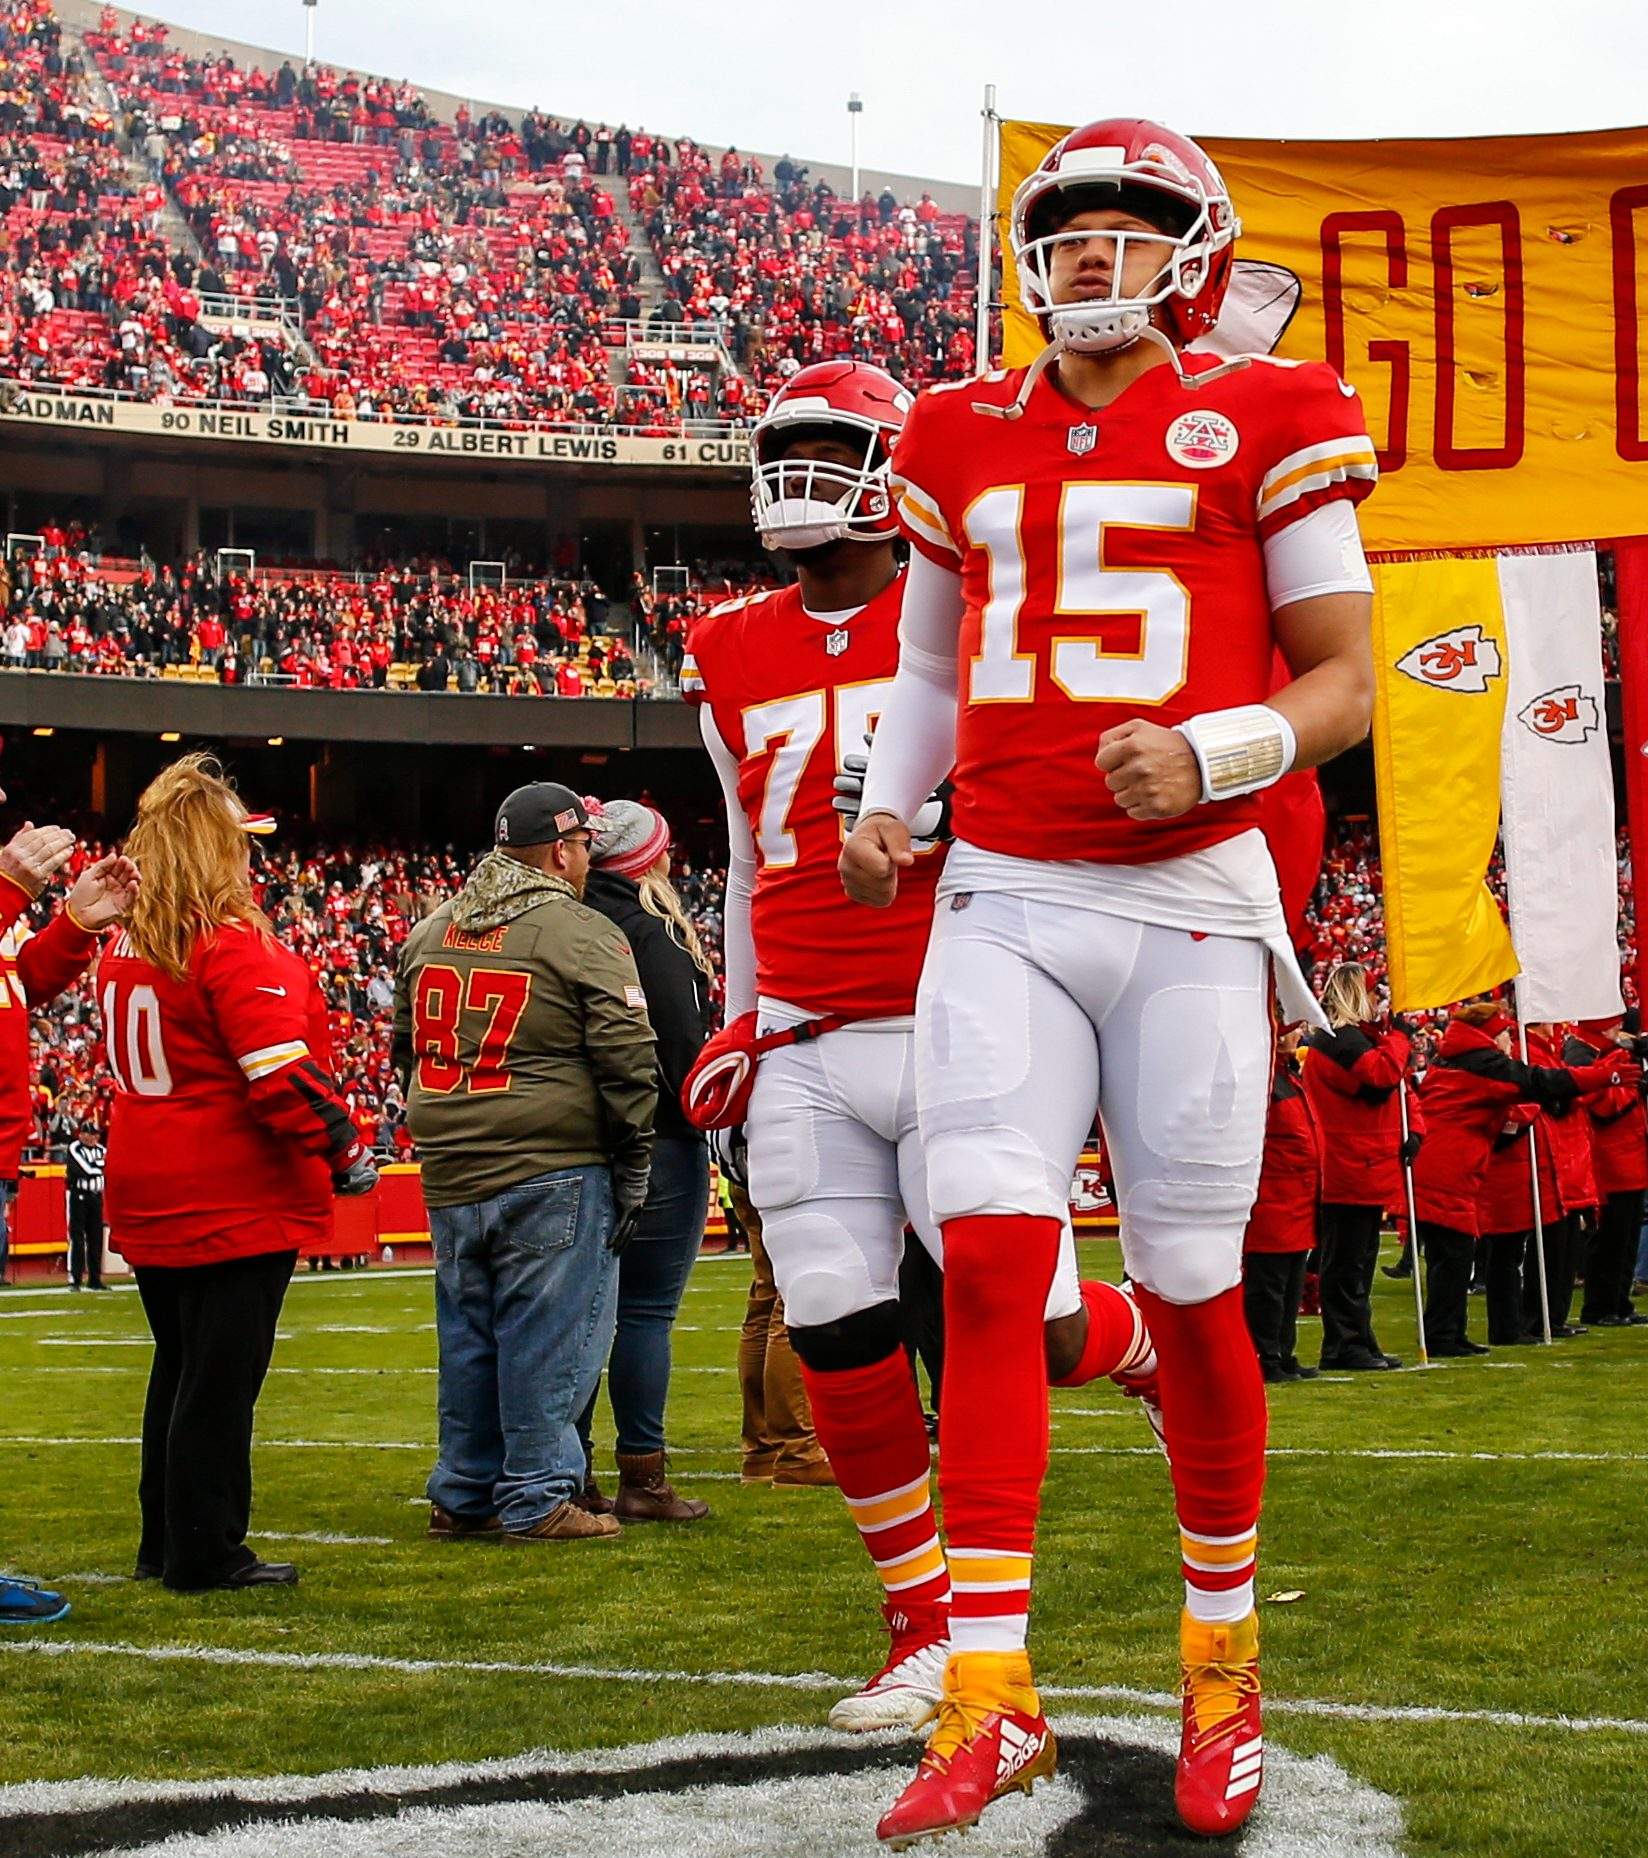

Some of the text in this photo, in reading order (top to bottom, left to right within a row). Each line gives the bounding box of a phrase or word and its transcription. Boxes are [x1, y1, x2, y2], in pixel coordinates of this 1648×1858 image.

[1320, 200, 1525, 473] GO
[161, 412, 349, 444] 90 NEIL SMITH
[393, 430, 618, 460] 29 ALBERT LEWIS
[663, 444, 687, 460] 61
[964, 480, 1198, 707] 15
[103, 980, 173, 1097] 10
[413, 963, 532, 1095] 87
